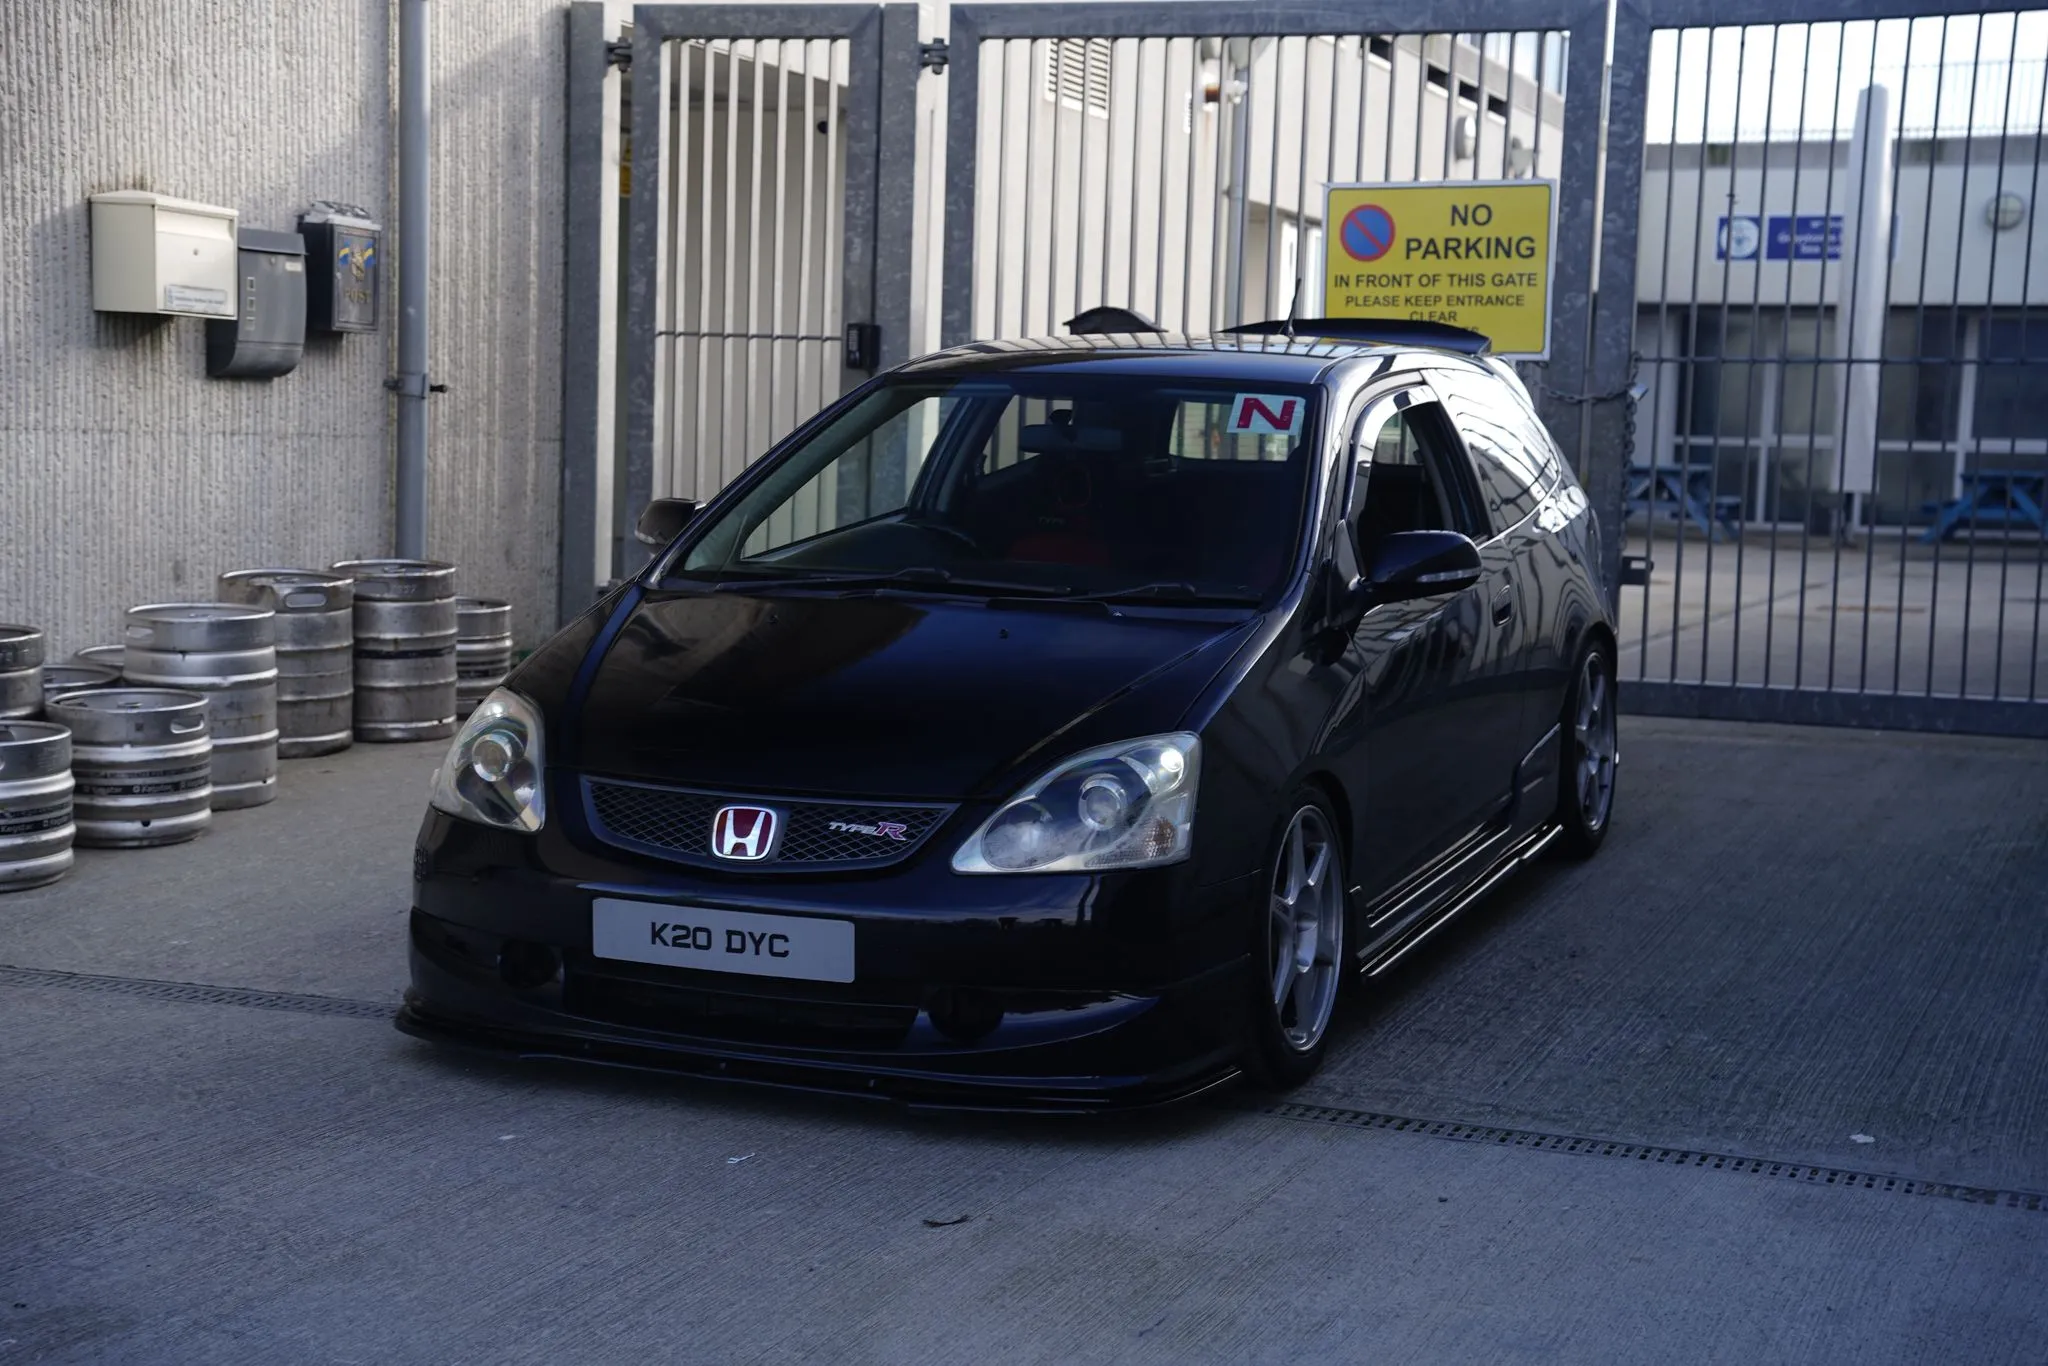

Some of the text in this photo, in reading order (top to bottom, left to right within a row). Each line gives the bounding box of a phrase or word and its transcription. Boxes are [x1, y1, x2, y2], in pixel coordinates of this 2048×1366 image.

[1450, 203, 1493, 227] NO
[1405, 236, 1536, 260] PARKING
[1334, 272, 1538, 288] IN FRONT OF THIS GATE
[1345, 294, 1525, 307] PLEASE KEEP ENTRANCE
[1409, 310, 1458, 323] CLEAR
[1236, 397, 1297, 431] N
[650, 921, 790, 958] K20 DYC
